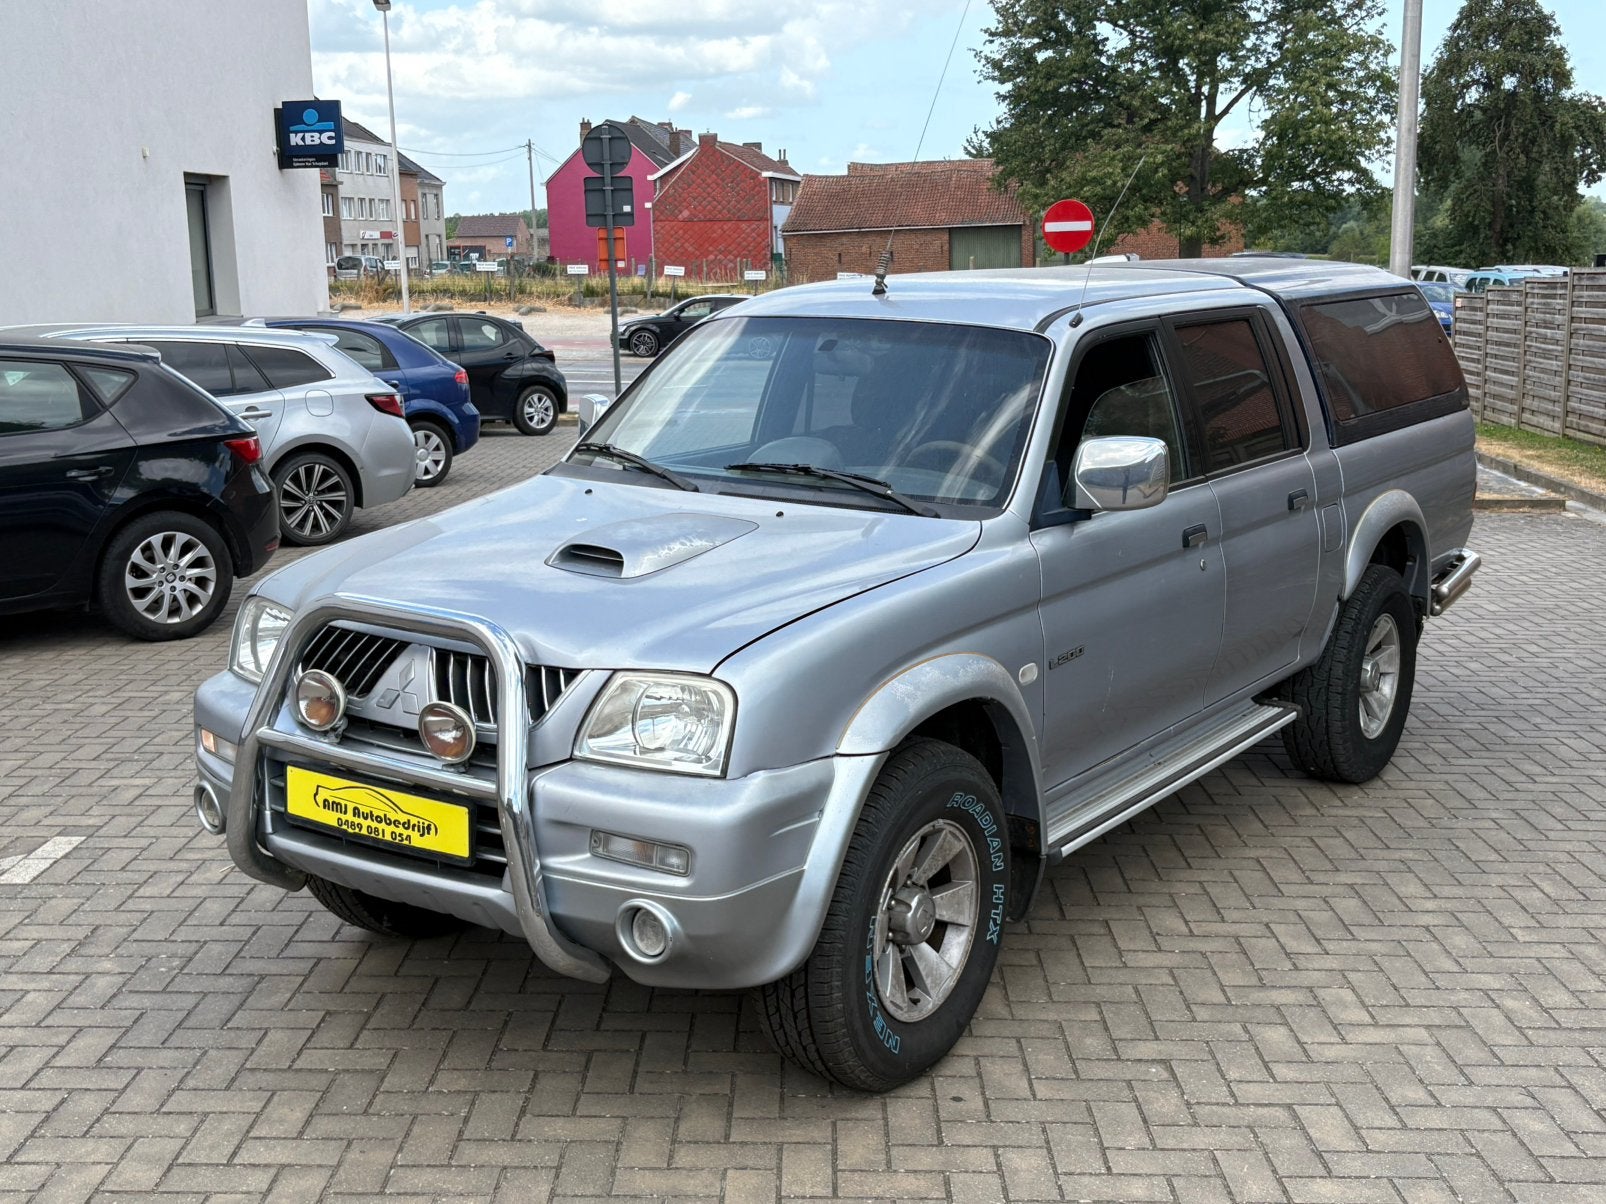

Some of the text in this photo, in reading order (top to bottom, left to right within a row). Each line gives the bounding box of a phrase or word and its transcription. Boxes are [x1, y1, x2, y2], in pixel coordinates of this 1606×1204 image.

[289, 131, 336, 146] KBC
[322, 797, 433, 838] AMJ Autobedrijf
[336, 816, 413, 845] 0489 081 054
[947, 792, 1005, 945] ROADIAN HTX
